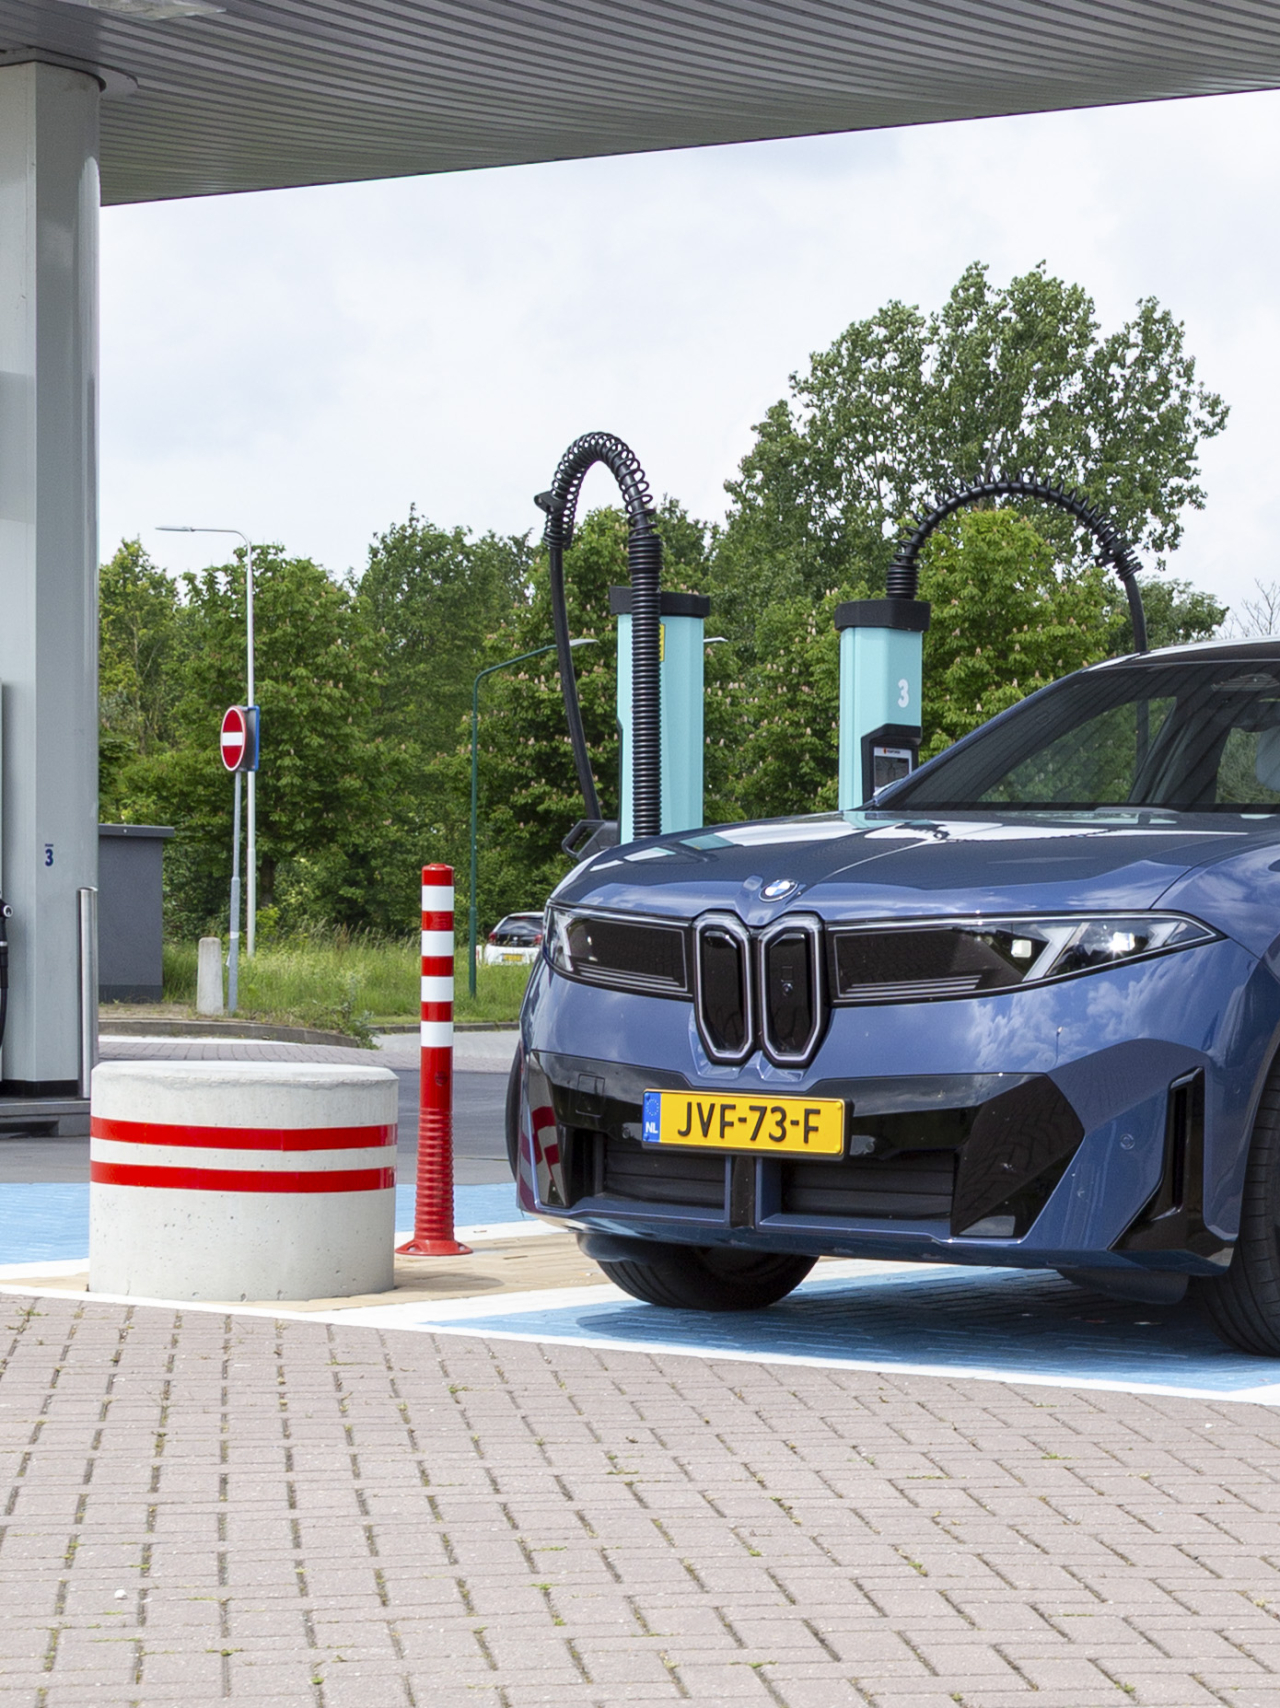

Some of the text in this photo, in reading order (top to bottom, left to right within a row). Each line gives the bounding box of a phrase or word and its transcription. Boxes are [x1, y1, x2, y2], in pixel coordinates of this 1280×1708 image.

[898, 679, 909, 708] 3
[45, 848, 54, 867] 3
[645, 1121, 658, 1134] NL
[677, 1101, 821, 1144] JVF-73-F
